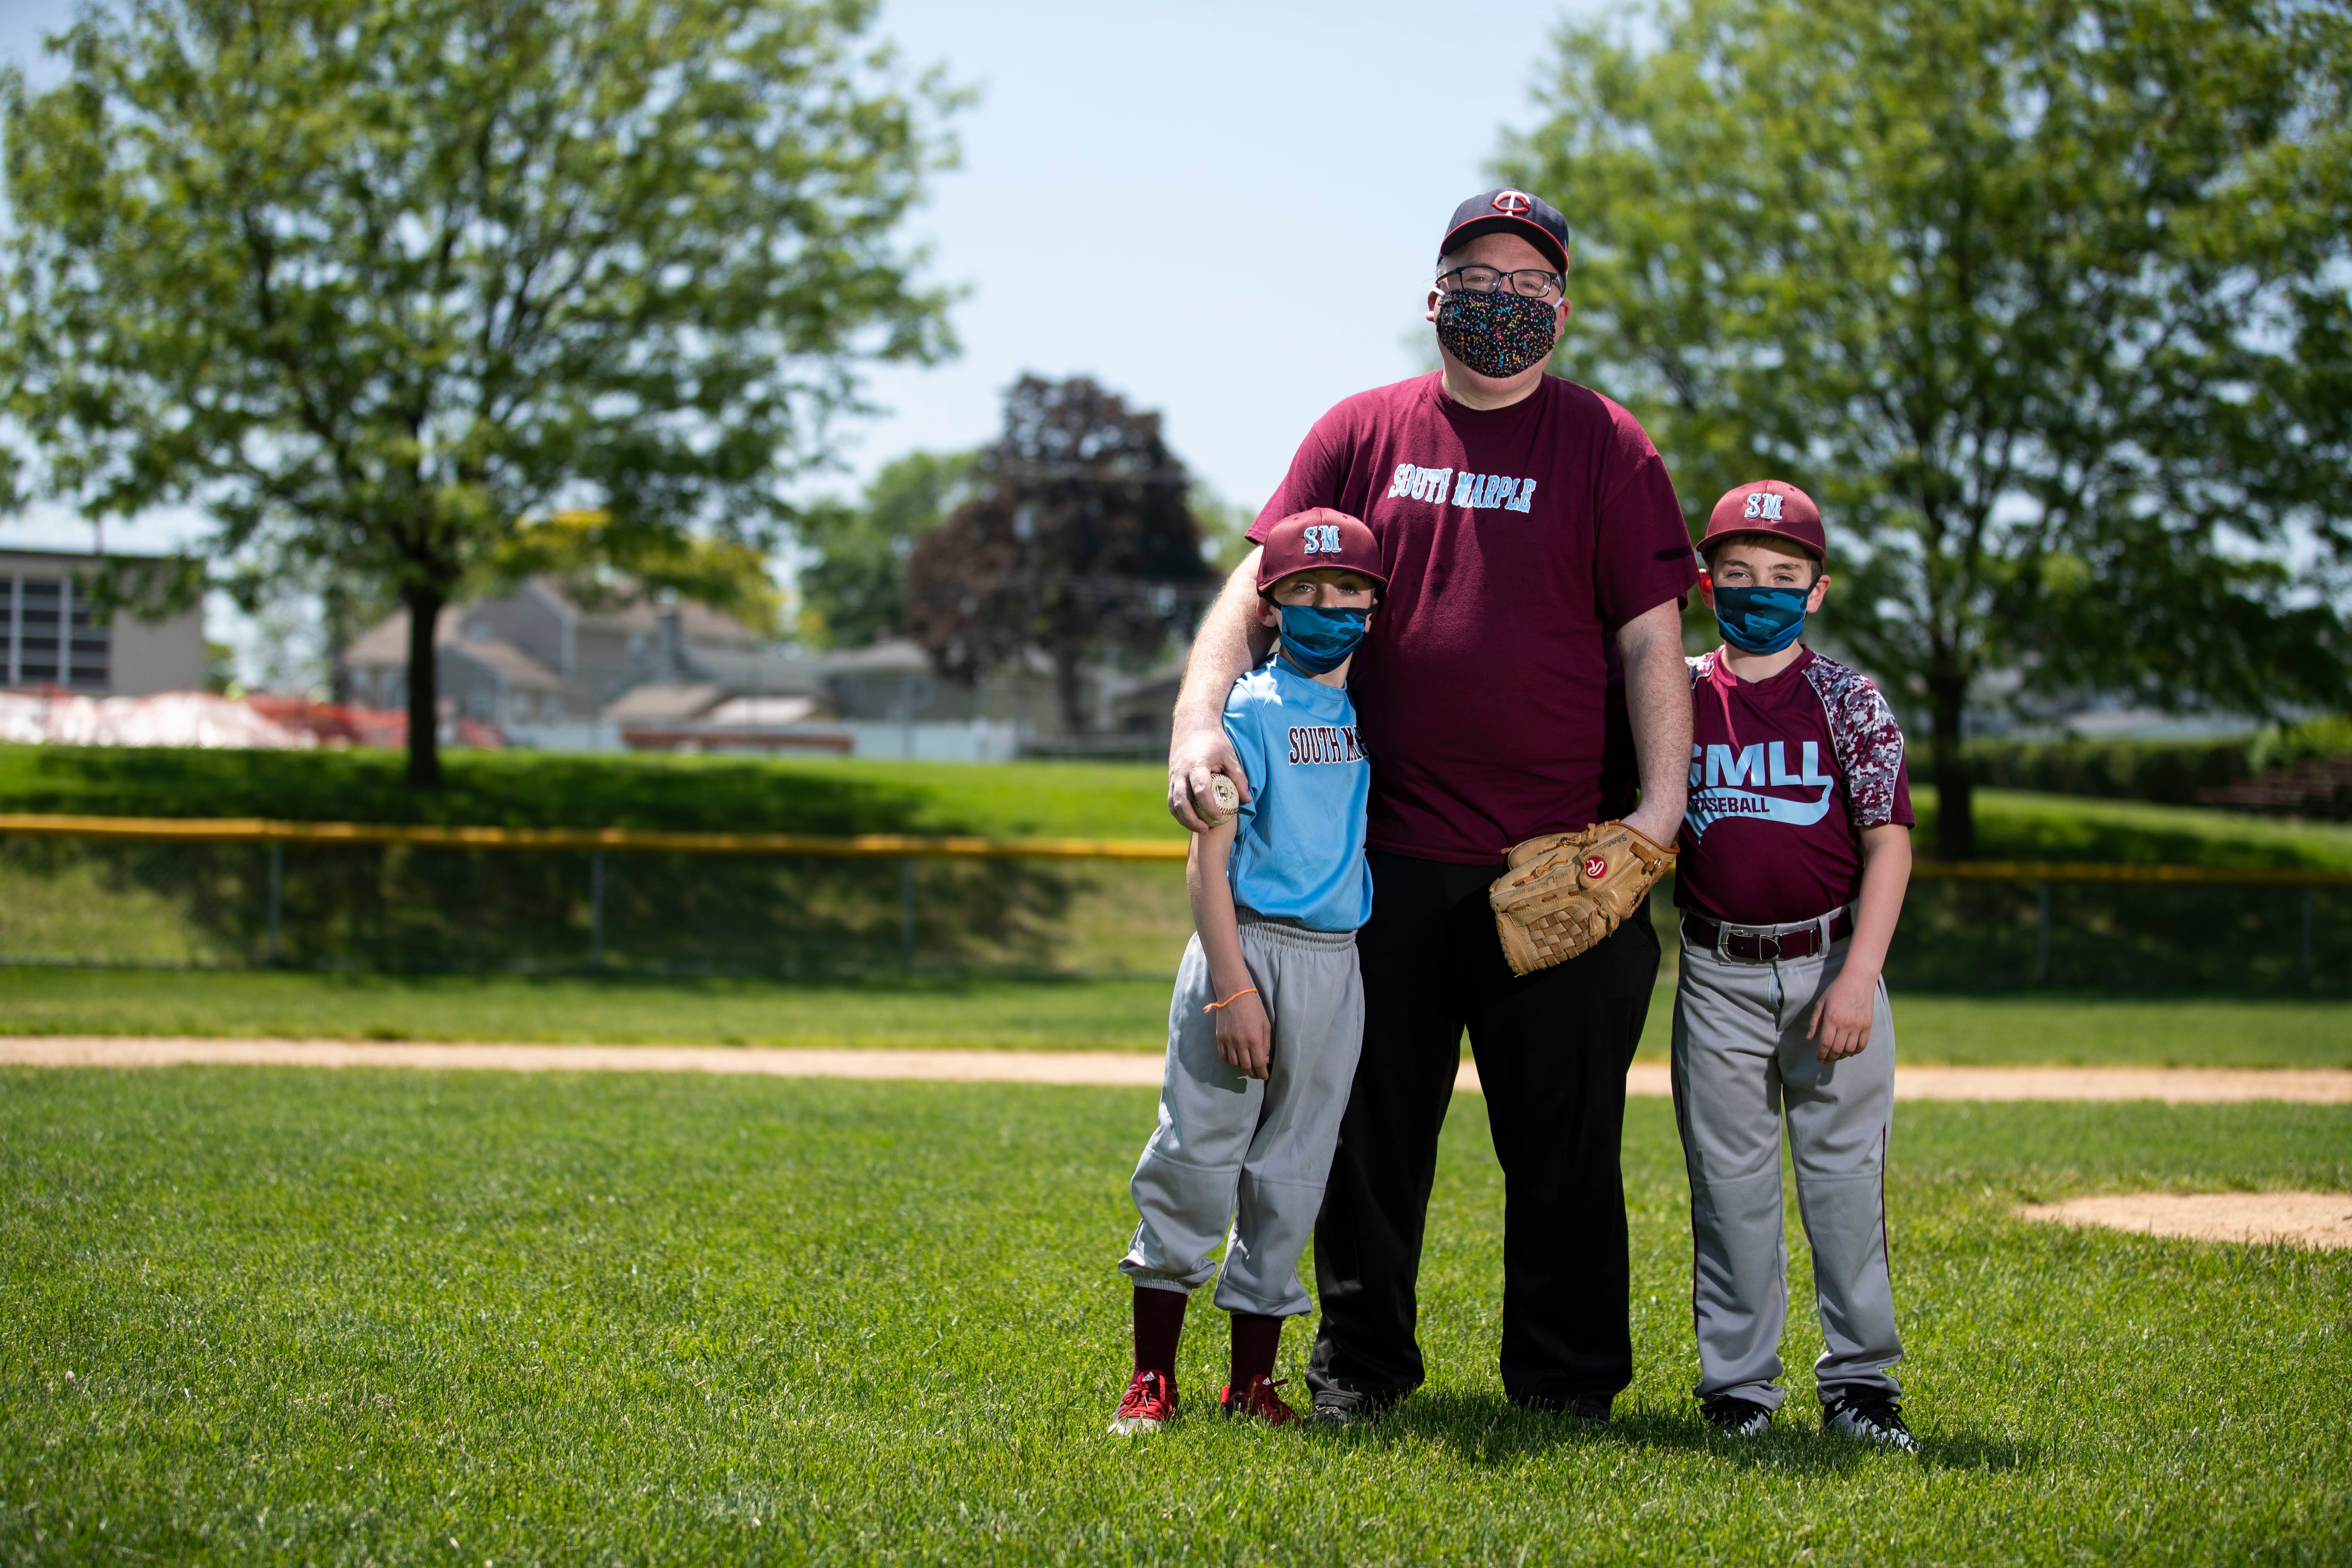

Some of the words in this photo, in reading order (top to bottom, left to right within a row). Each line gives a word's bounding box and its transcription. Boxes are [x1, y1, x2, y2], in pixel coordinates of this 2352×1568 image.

[1387, 463, 1453, 504] SOUTH
[1452, 471, 1536, 513] MARPLE
[1744, 493, 1783, 520] SM
[1304, 525, 1342, 554] SM
[1288, 726, 1342, 765] SOUTH
[1608, 835, 1627, 847] Silver
